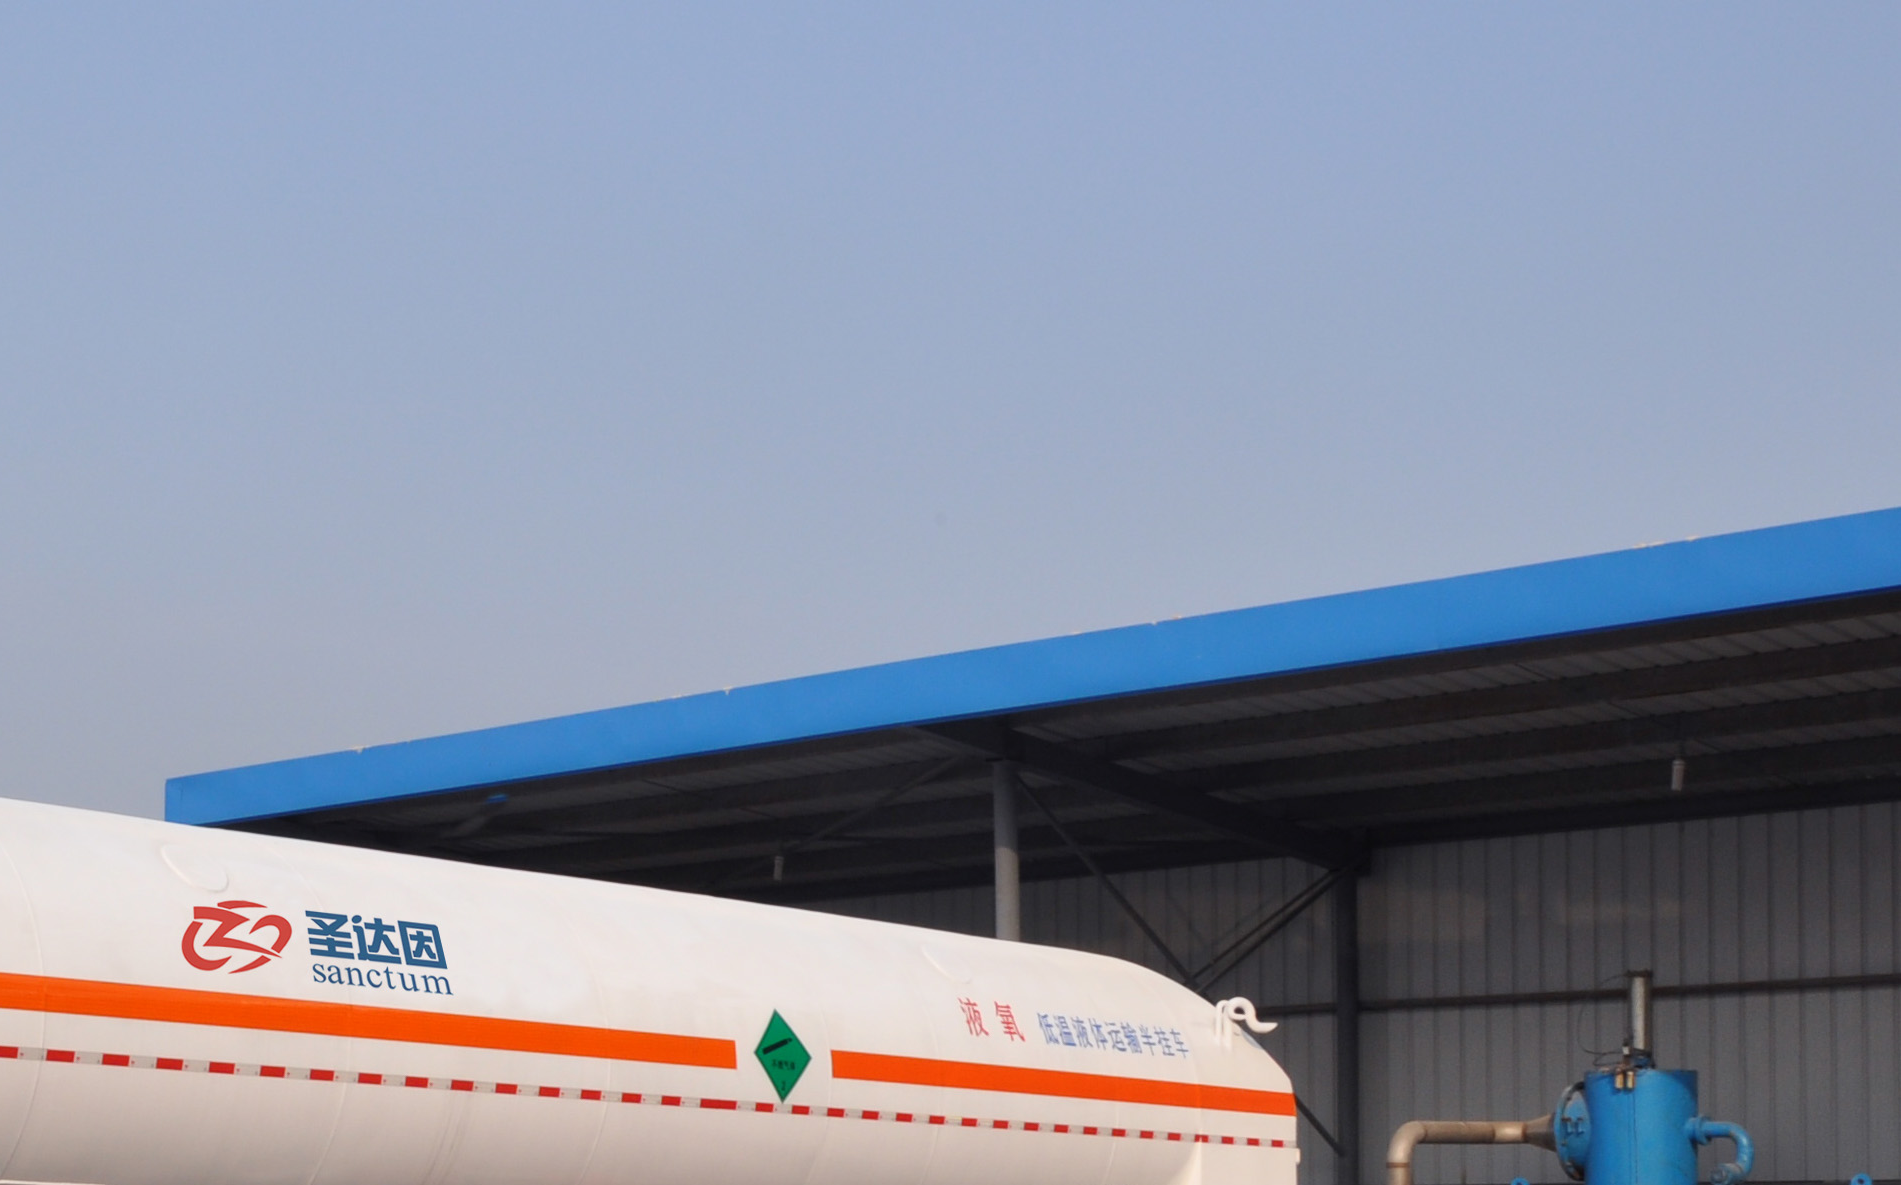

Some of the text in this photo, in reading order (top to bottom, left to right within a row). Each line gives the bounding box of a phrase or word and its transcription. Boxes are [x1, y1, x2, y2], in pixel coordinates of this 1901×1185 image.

[305, 910, 448, 969] 圣达因
[312, 962, 454, 996] sanctum
[958, 997, 1026, 1043] 液氧
[1037, 1012, 1189, 1059] 低温液体运输半挂车
